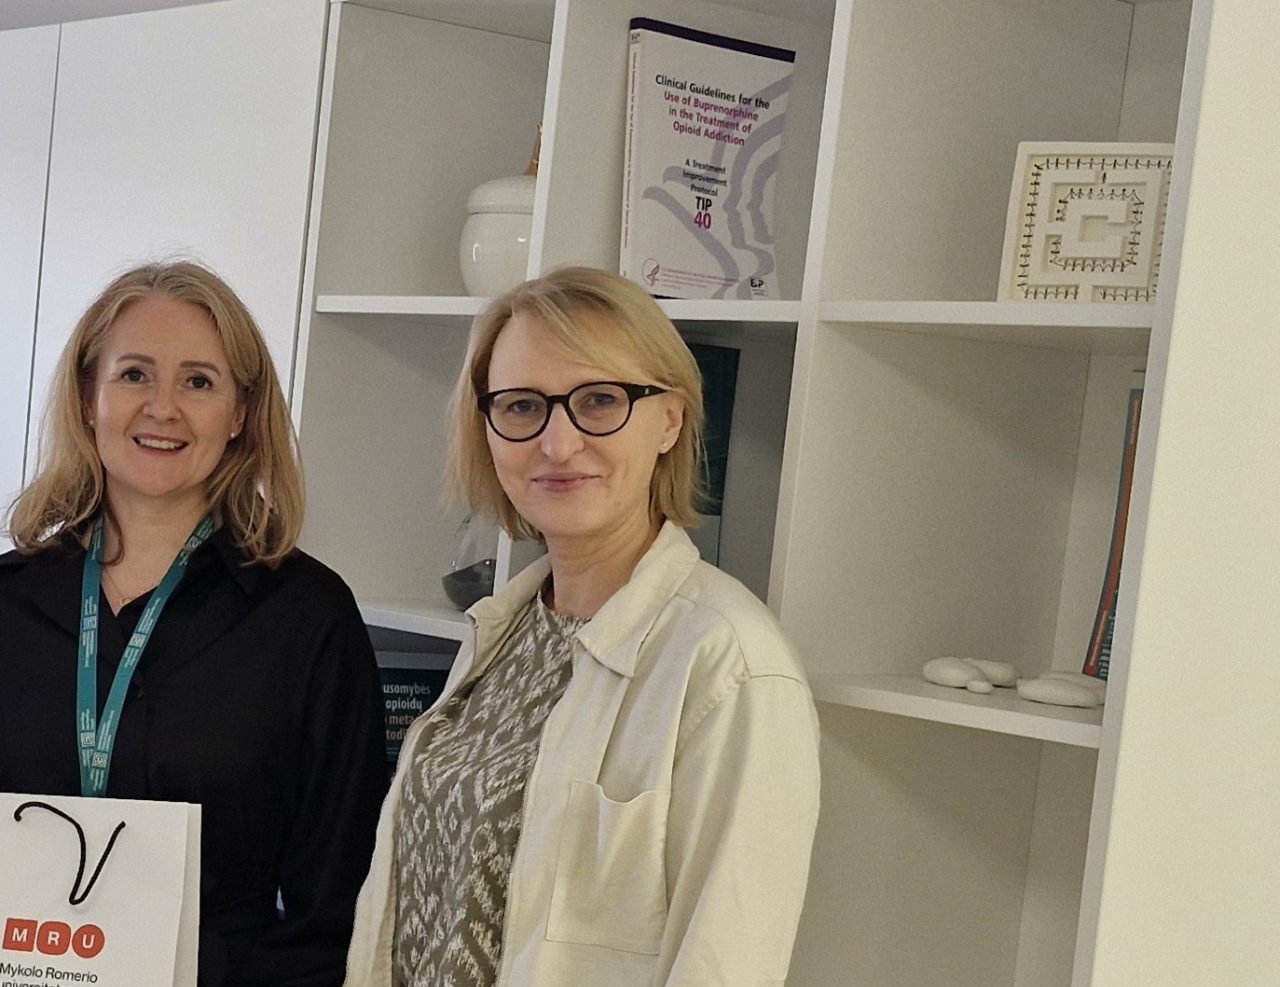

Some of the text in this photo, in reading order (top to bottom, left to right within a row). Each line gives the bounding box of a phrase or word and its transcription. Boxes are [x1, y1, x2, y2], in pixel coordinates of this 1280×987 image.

[655, 74, 769, 109] Clinical Guidelines for the
[664, 91, 759, 122] Use of Buprenorphine
[669, 107, 752, 134] in the Treatment of
[673, 121, 745, 146] Opioid Addiction
[692, 160, 726, 174] Treatment
[690, 184, 718, 196] Protocol
[695, 196, 712, 212] TIP
[694, 211, 711, 229] 40
[8, 924, 99, 952] MRU
[0, 962, 98, 984] Mykolo Romerio
